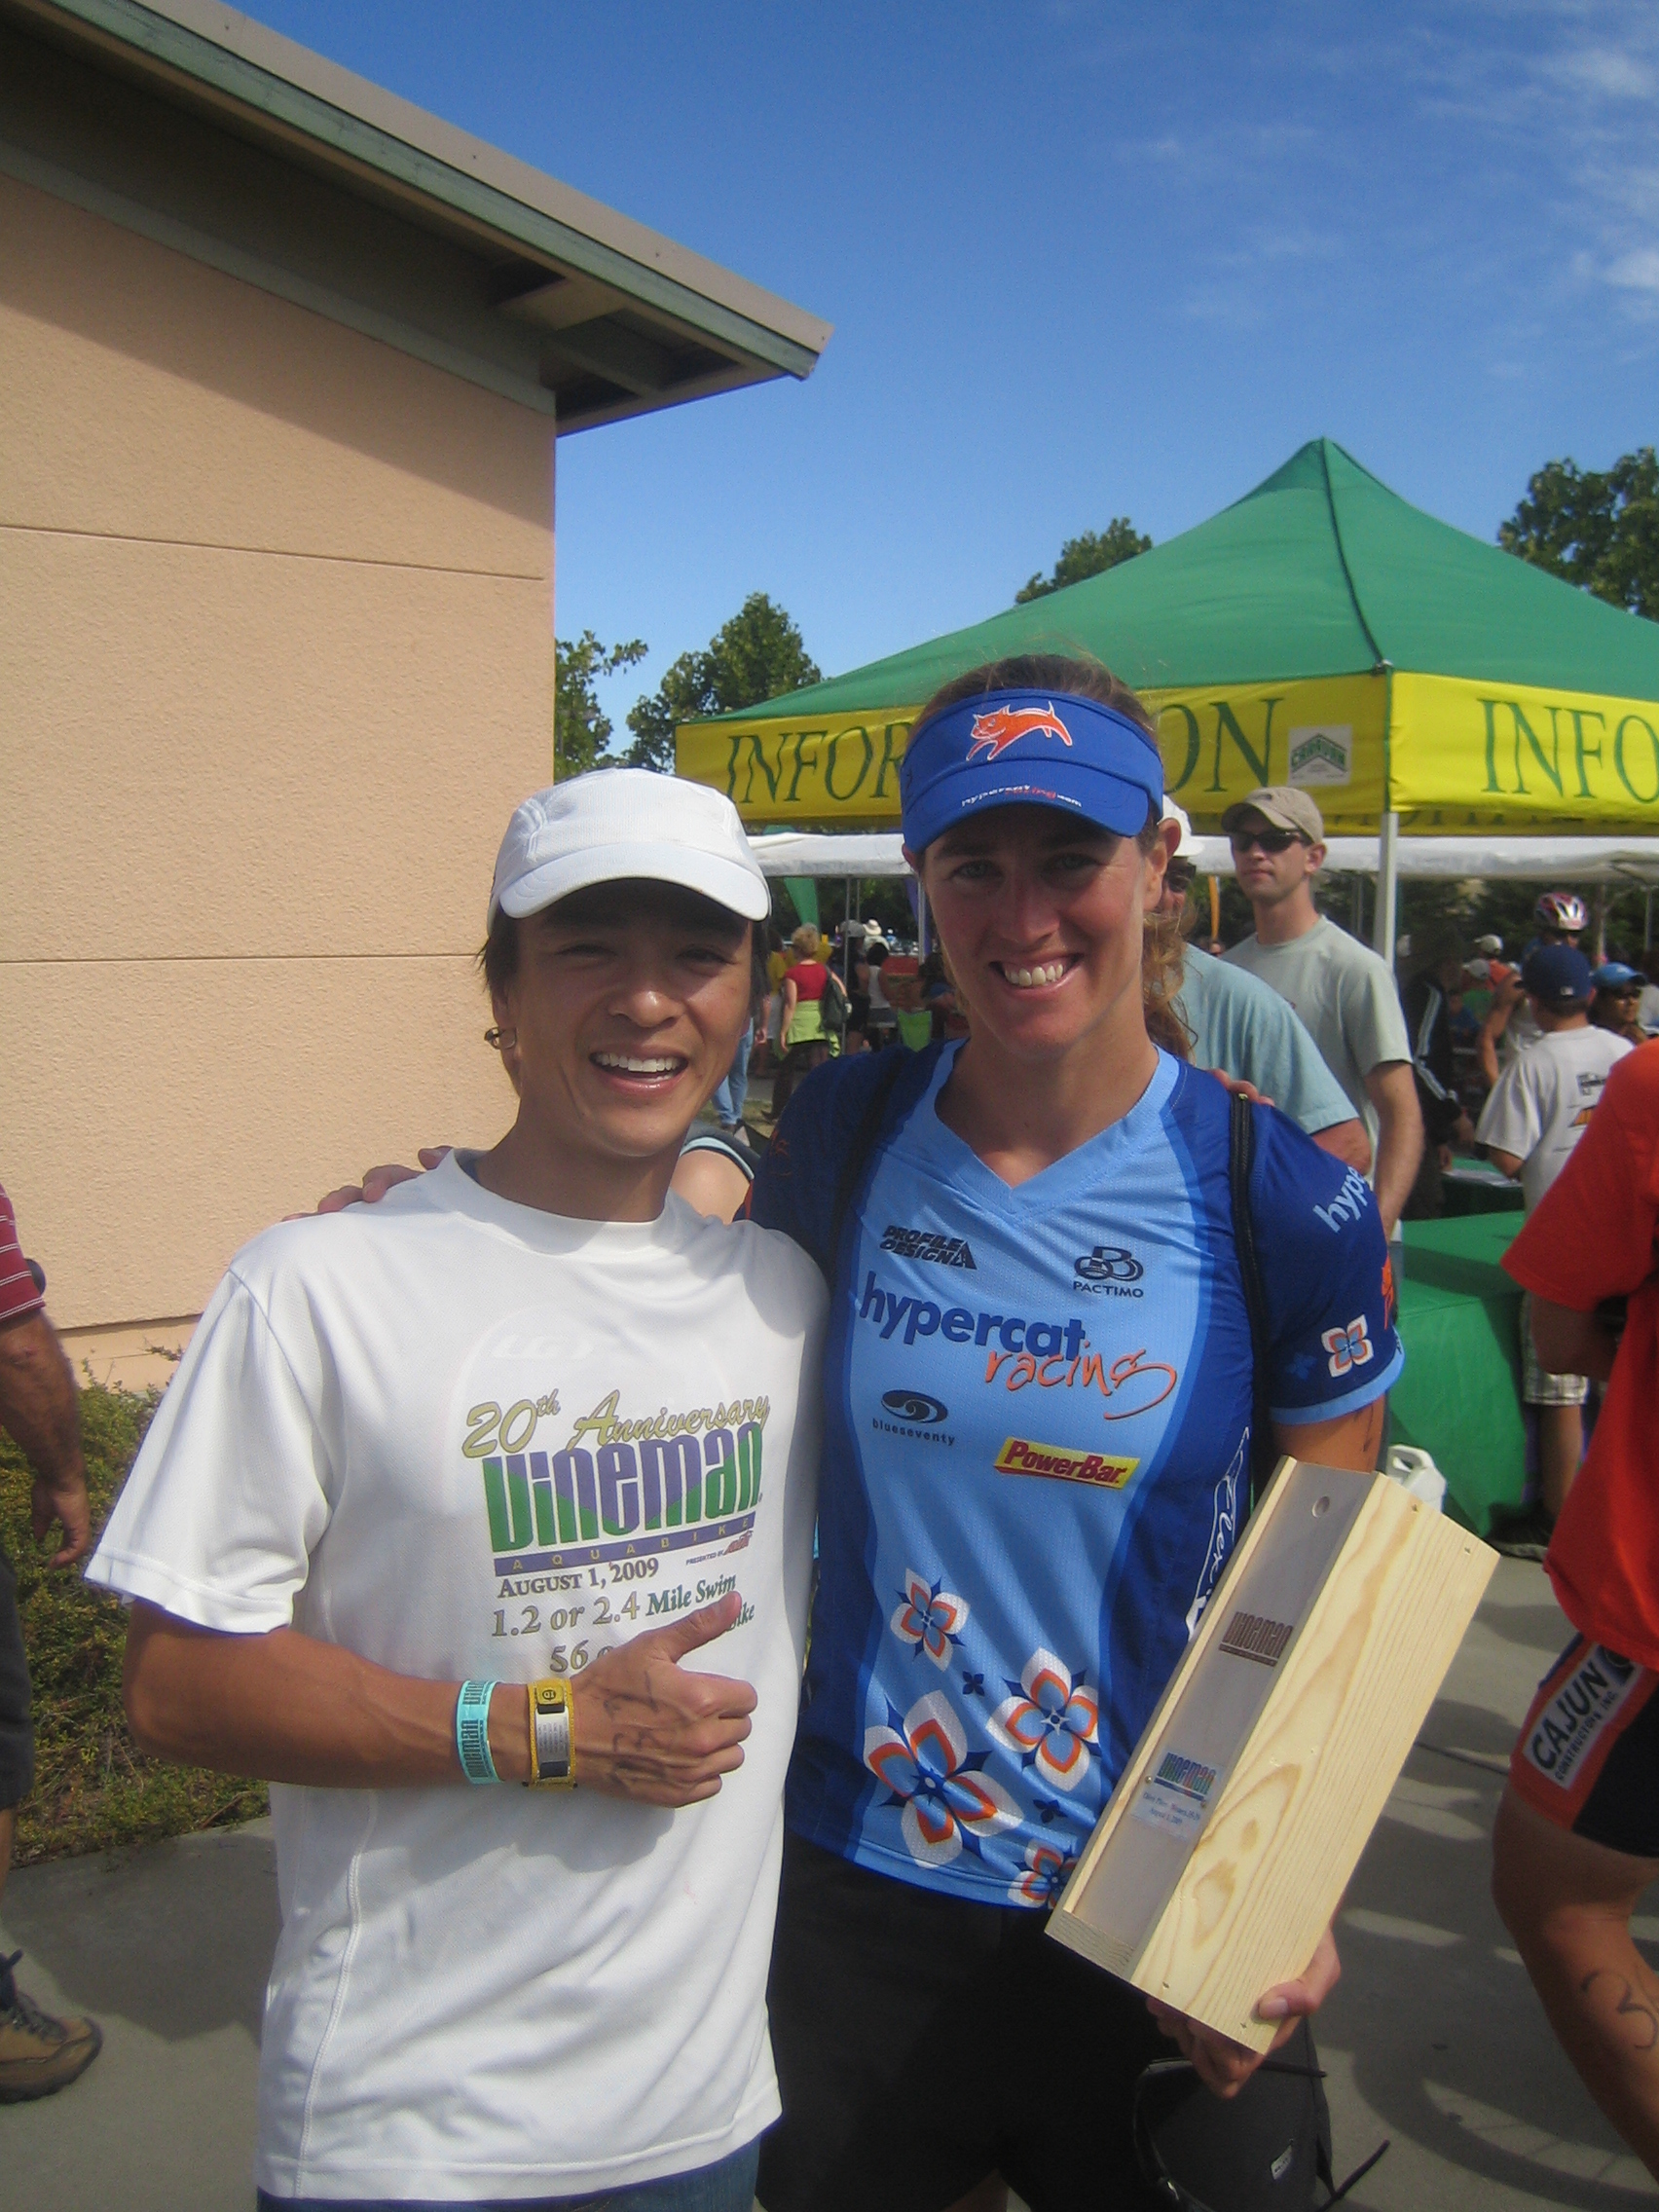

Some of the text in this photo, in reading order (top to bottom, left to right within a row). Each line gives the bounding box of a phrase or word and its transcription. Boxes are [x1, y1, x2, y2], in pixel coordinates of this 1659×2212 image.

[1477, 698, 1659, 805] INFO
[879, 1238, 968, 1269] DESIGN
[882, 1224, 965, 1252] PROFILE
[859, 1271, 1087, 1361] hypercat
[1073, 1280, 1144, 1299] PACTIMO
[985, 1341, 1177, 1420] racing
[461, 1388, 771, 1458] 20th Anniversary
[871, 1418, 956, 1447] blueseventy
[1004, 1439, 1128, 1485] PowerBar
[492, 1573, 737, 1637] 1.2 or 2.4 Mile Swim
[498, 1558, 660, 1599] AUGUST 1, 2009
[550, 1641, 589, 1673] 56
[725, 1602, 755, 1631] ike
[1531, 1660, 1608, 1770] CAJUN
